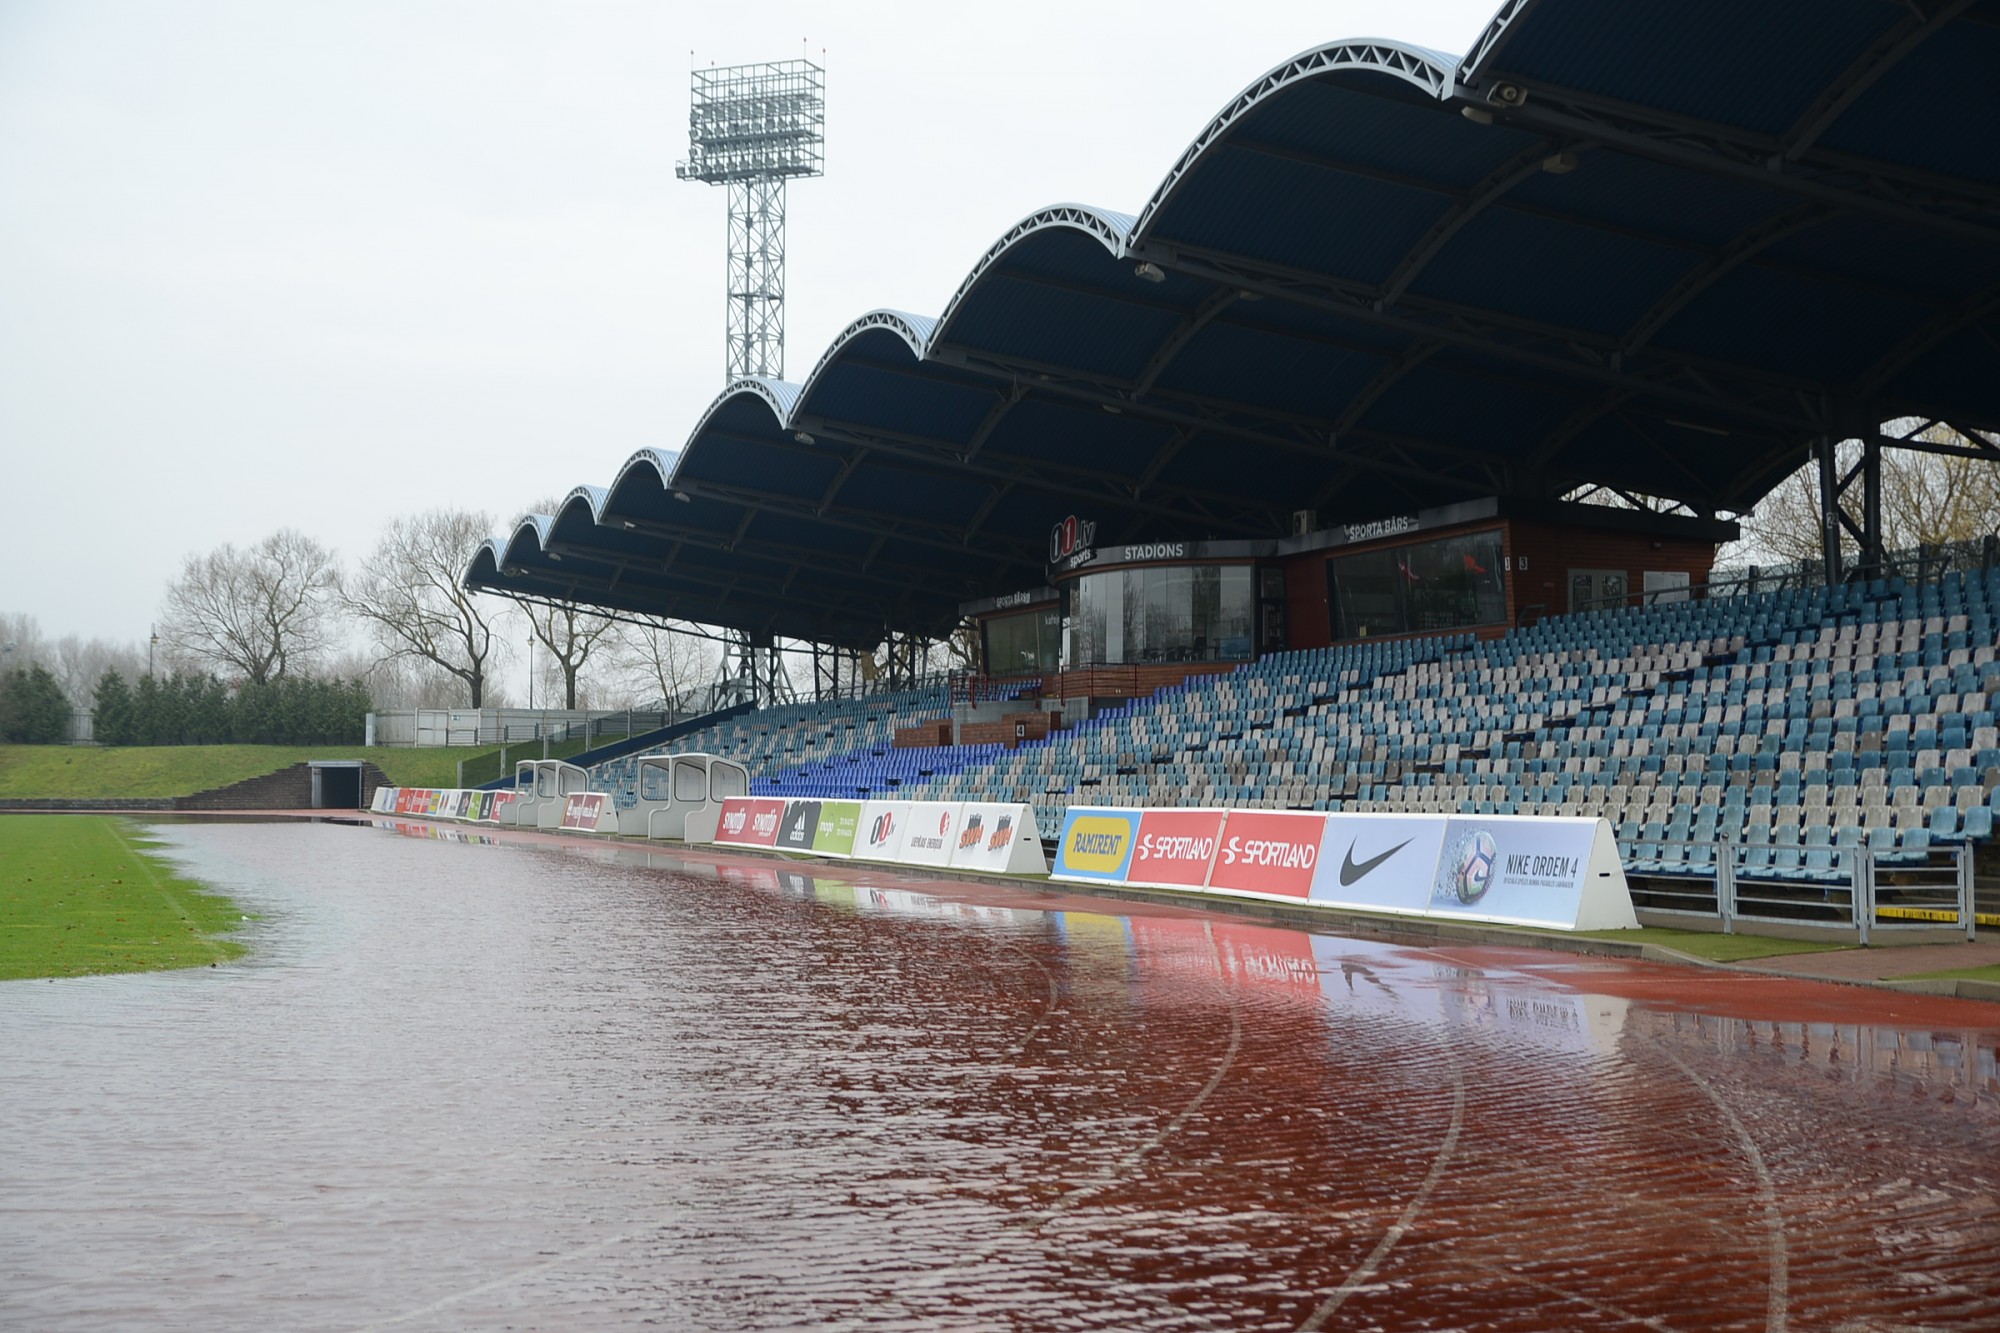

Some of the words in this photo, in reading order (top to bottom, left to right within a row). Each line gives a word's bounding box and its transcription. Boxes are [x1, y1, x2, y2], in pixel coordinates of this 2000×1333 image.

[1350, 520, 1383, 540] SPORTA
[1384, 516, 1408, 534] BĀRS
[1070, 548, 1091, 568] sports
[1124, 543, 1184, 560] STADIONS
[1017, 725, 1023, 736] 4
[1072, 832, 1122, 856] RAMIRENT
[1153, 836, 1213, 861] SPORTLAND
[1241, 840, 1315, 869] SPORTLAND
[1505, 854, 1531, 875] NIKE
[1531, 856, 1570, 878] ORDEM
[1570, 858, 1579, 878] 4
